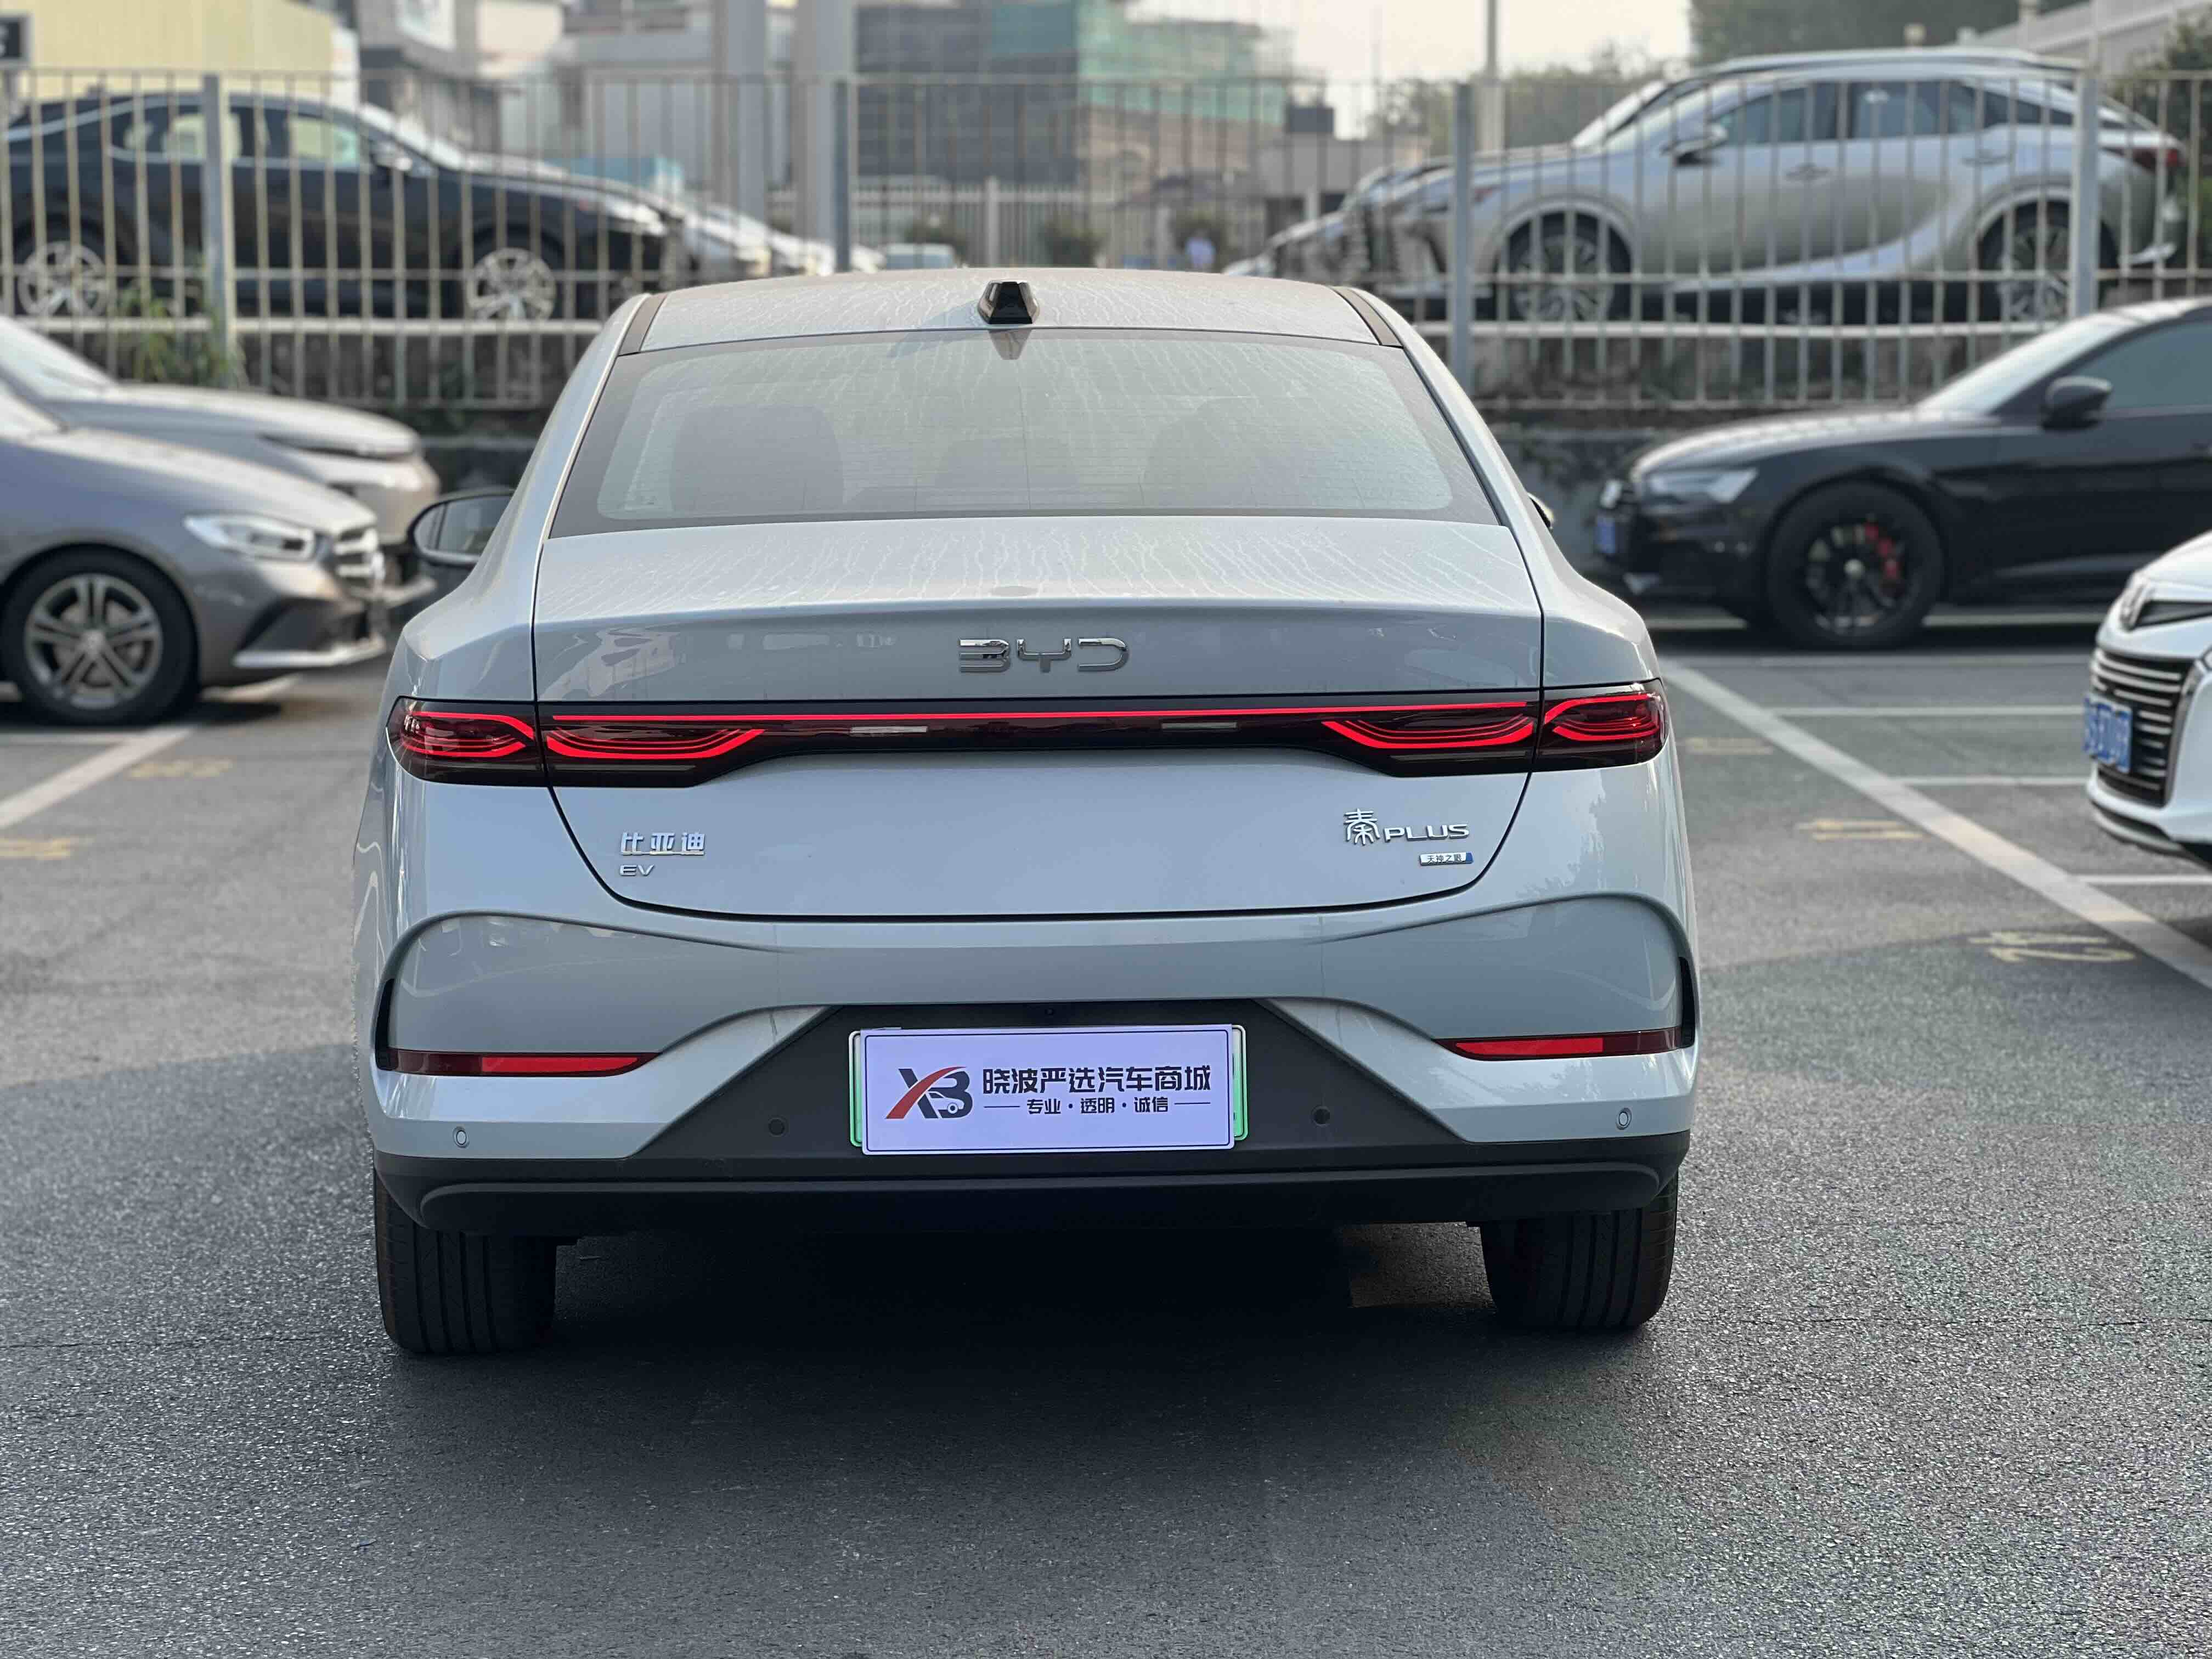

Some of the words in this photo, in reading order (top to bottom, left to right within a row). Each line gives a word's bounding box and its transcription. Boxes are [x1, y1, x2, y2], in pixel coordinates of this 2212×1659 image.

[959, 638, 1129, 673] BYD
[1344, 808, 1381, 845] 秦
[1383, 823, 1470, 843] PLUS
[620, 832, 705, 856] 比亚迪
[619, 864, 654, 877] EV
[983, 1065, 1211, 1094] 晓波严选汽车商城
